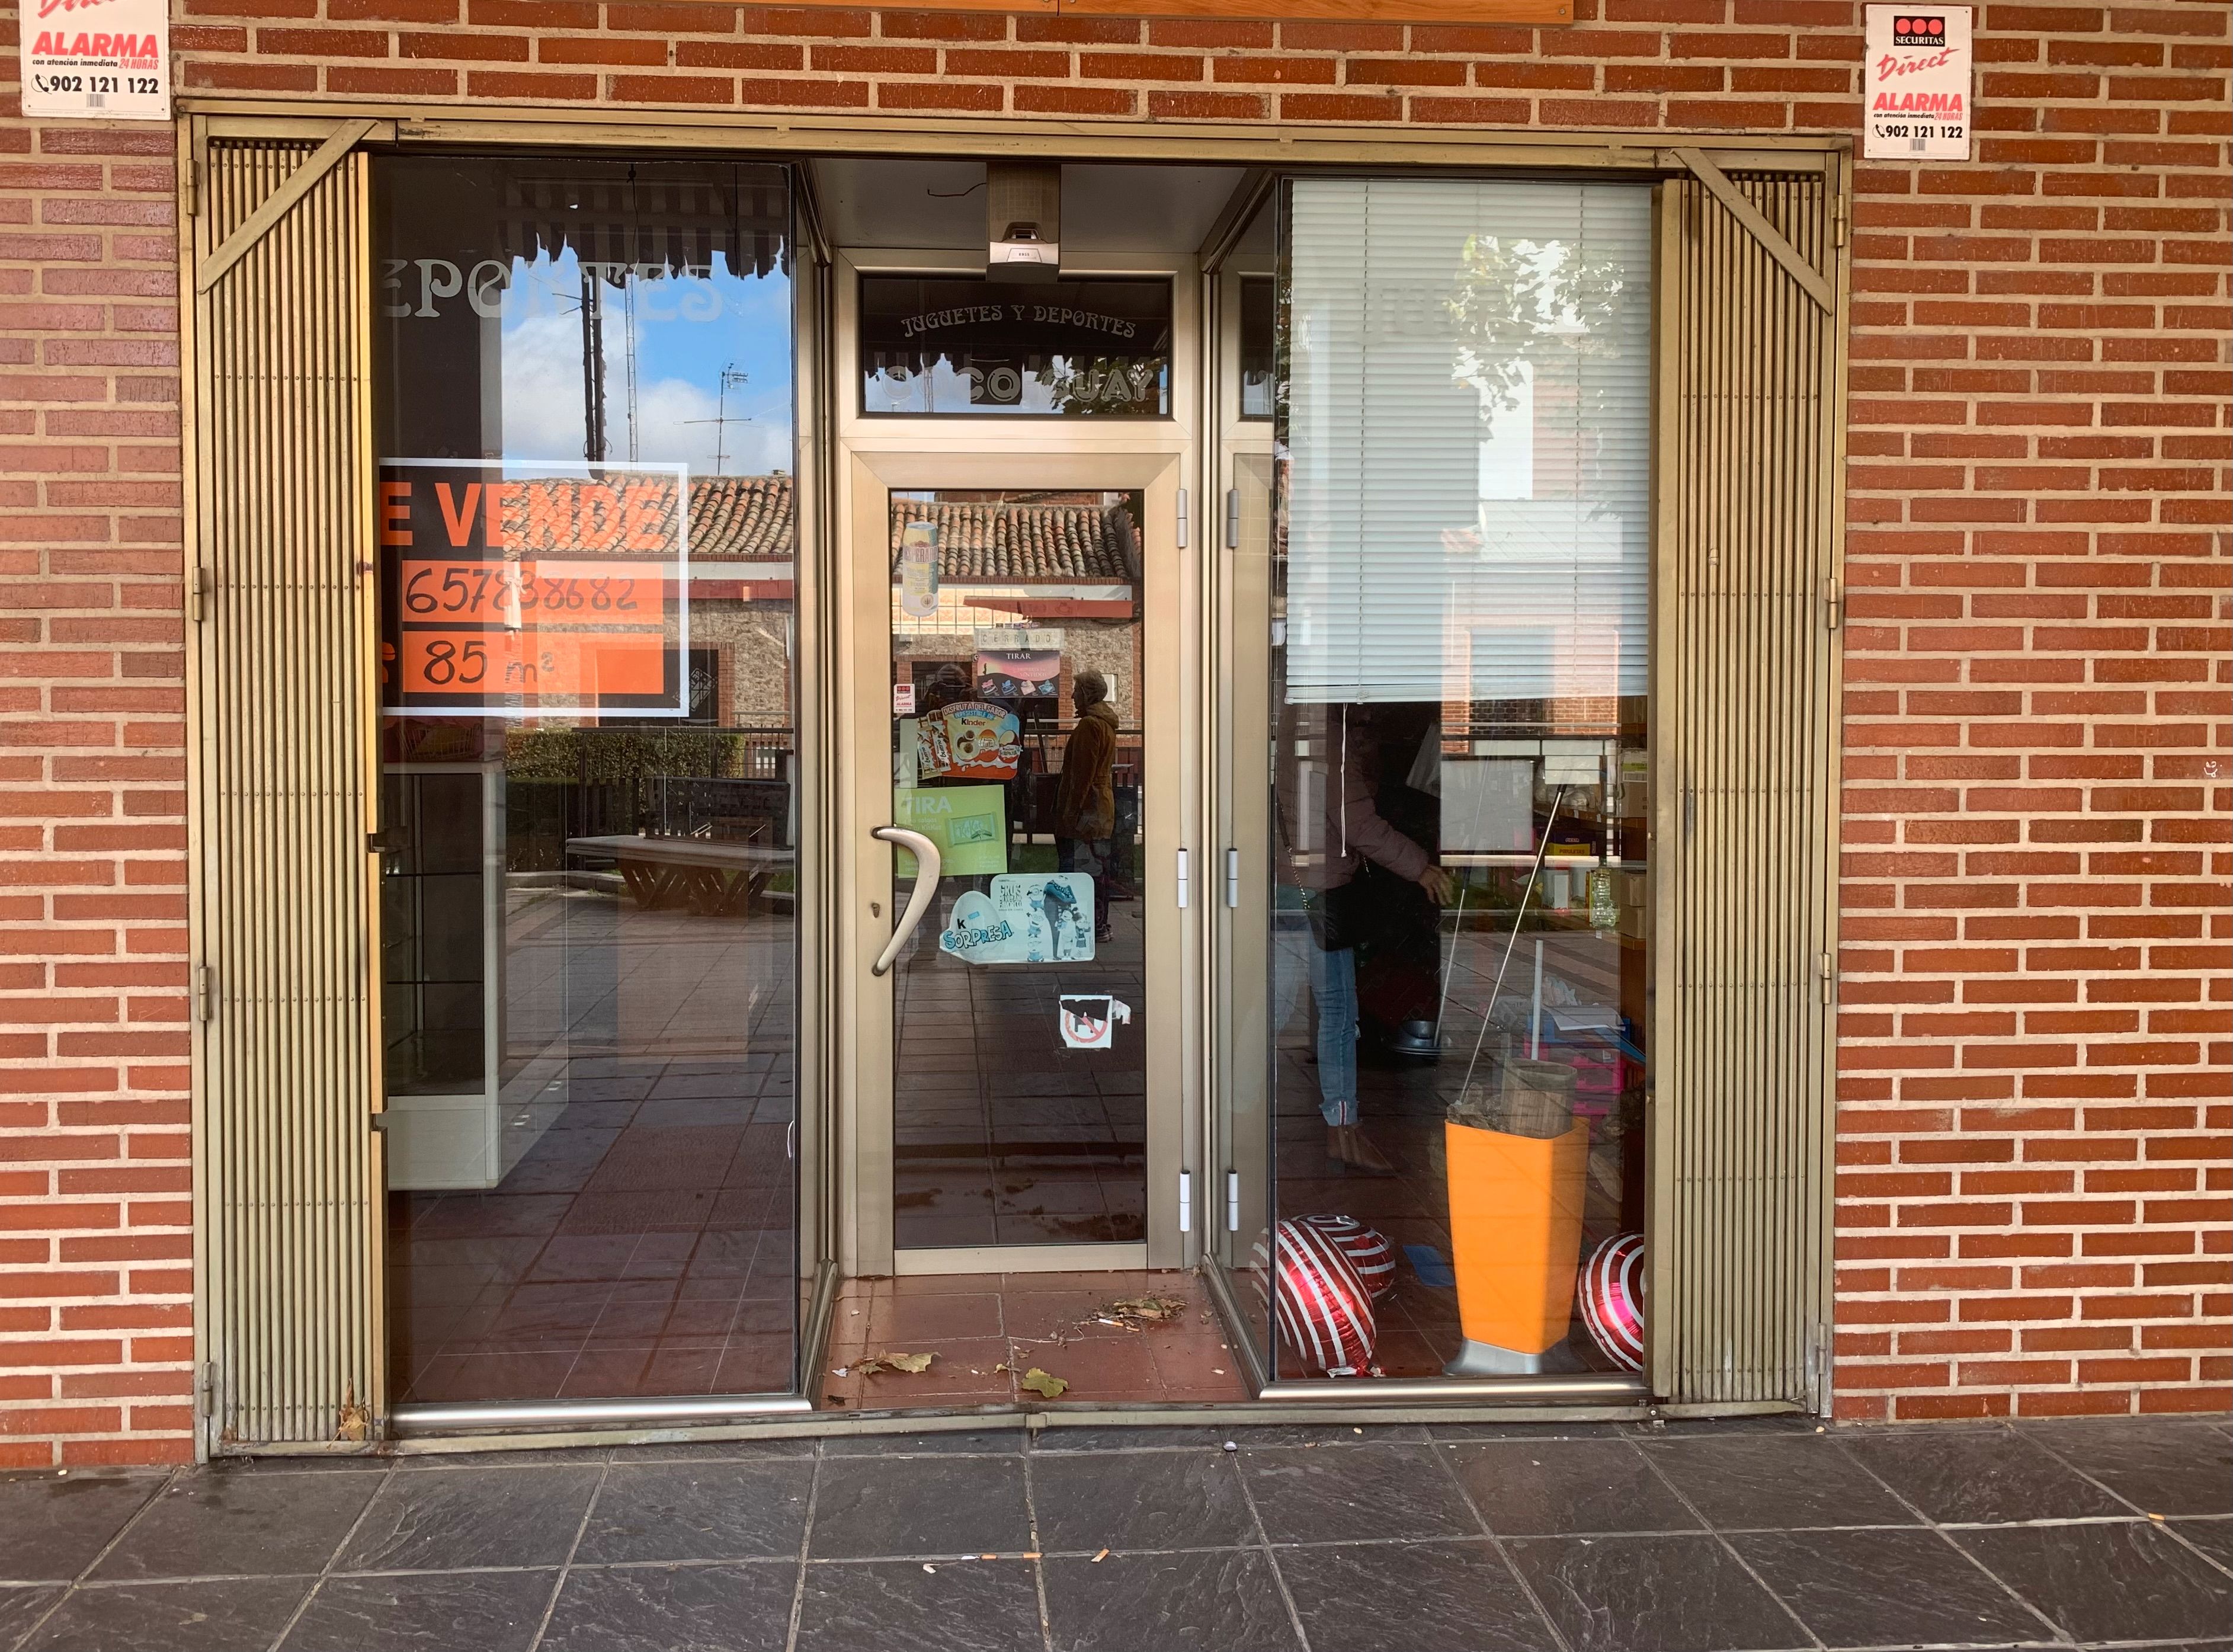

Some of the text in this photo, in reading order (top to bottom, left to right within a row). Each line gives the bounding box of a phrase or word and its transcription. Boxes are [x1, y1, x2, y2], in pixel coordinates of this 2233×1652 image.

[31, 31, 158, 58] ALARMA
[1896, 36, 1944, 45] SECURITAS
[47, 58, 78, 66] atención
[119, 59, 129, 69] 24
[131, 59, 159, 70] HORAS
[1876, 47, 1960, 82] Direct
[50, 75, 159, 94] 902 121 122
[1873, 92, 1963, 111] ALARMA
[1886, 125, 1963, 138] 902 121 122
[901, 305, 1137, 338] JUGUETES Y DEPORTES
[435, 482, 664, 550] VENDE
[982, 634, 1051, 643] CERRADO
[424, 641, 488, 684] 85
[943, 703, 1006, 718] DISFRUTA DEL SABOR
[904, 796, 953, 815] TIRA
[943, 920, 1013, 949] SORPRESA
